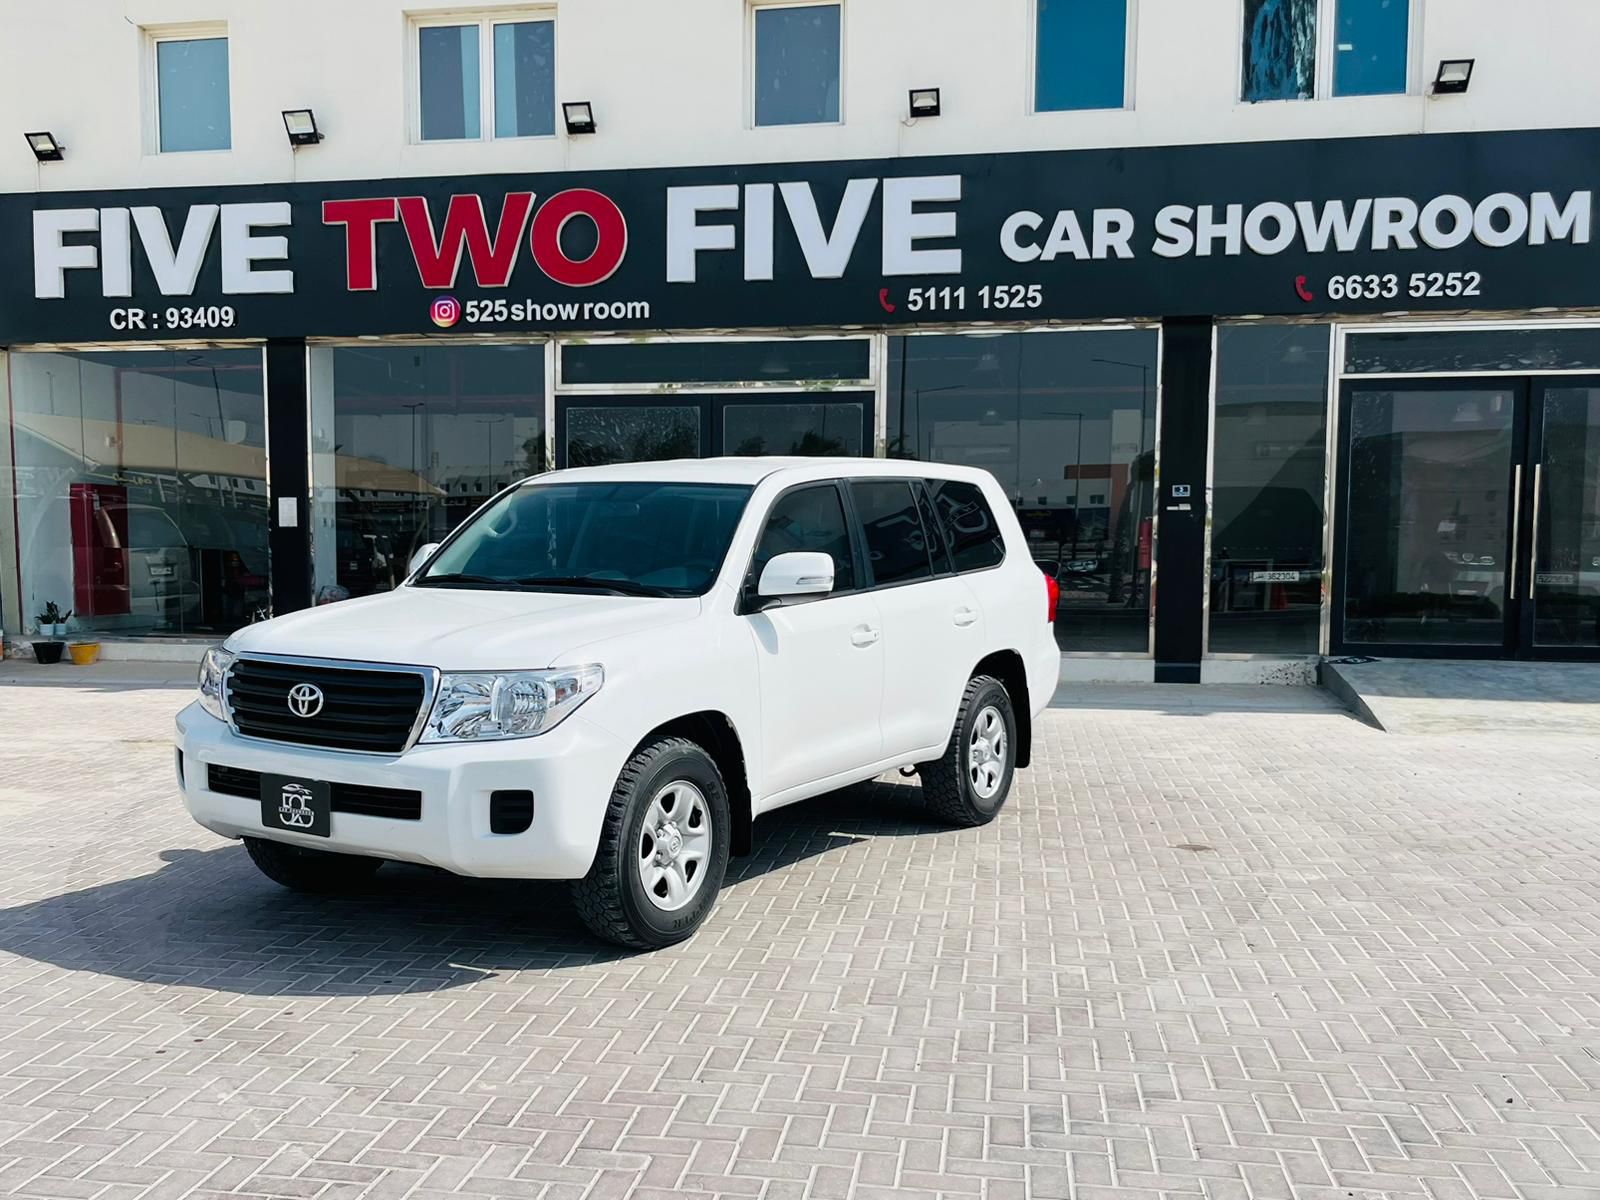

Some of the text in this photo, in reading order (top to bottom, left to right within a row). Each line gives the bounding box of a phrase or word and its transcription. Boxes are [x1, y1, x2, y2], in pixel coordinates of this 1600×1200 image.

[33, 174, 1592, 299] FIVE TWO FIVE CAR SHOWROOM
[907, 284, 1043, 311] 5111 1525
[1327, 271, 1481, 300] 6633 5252
[109, 308, 147, 330] CR
[165, 306, 235, 329] 93409
